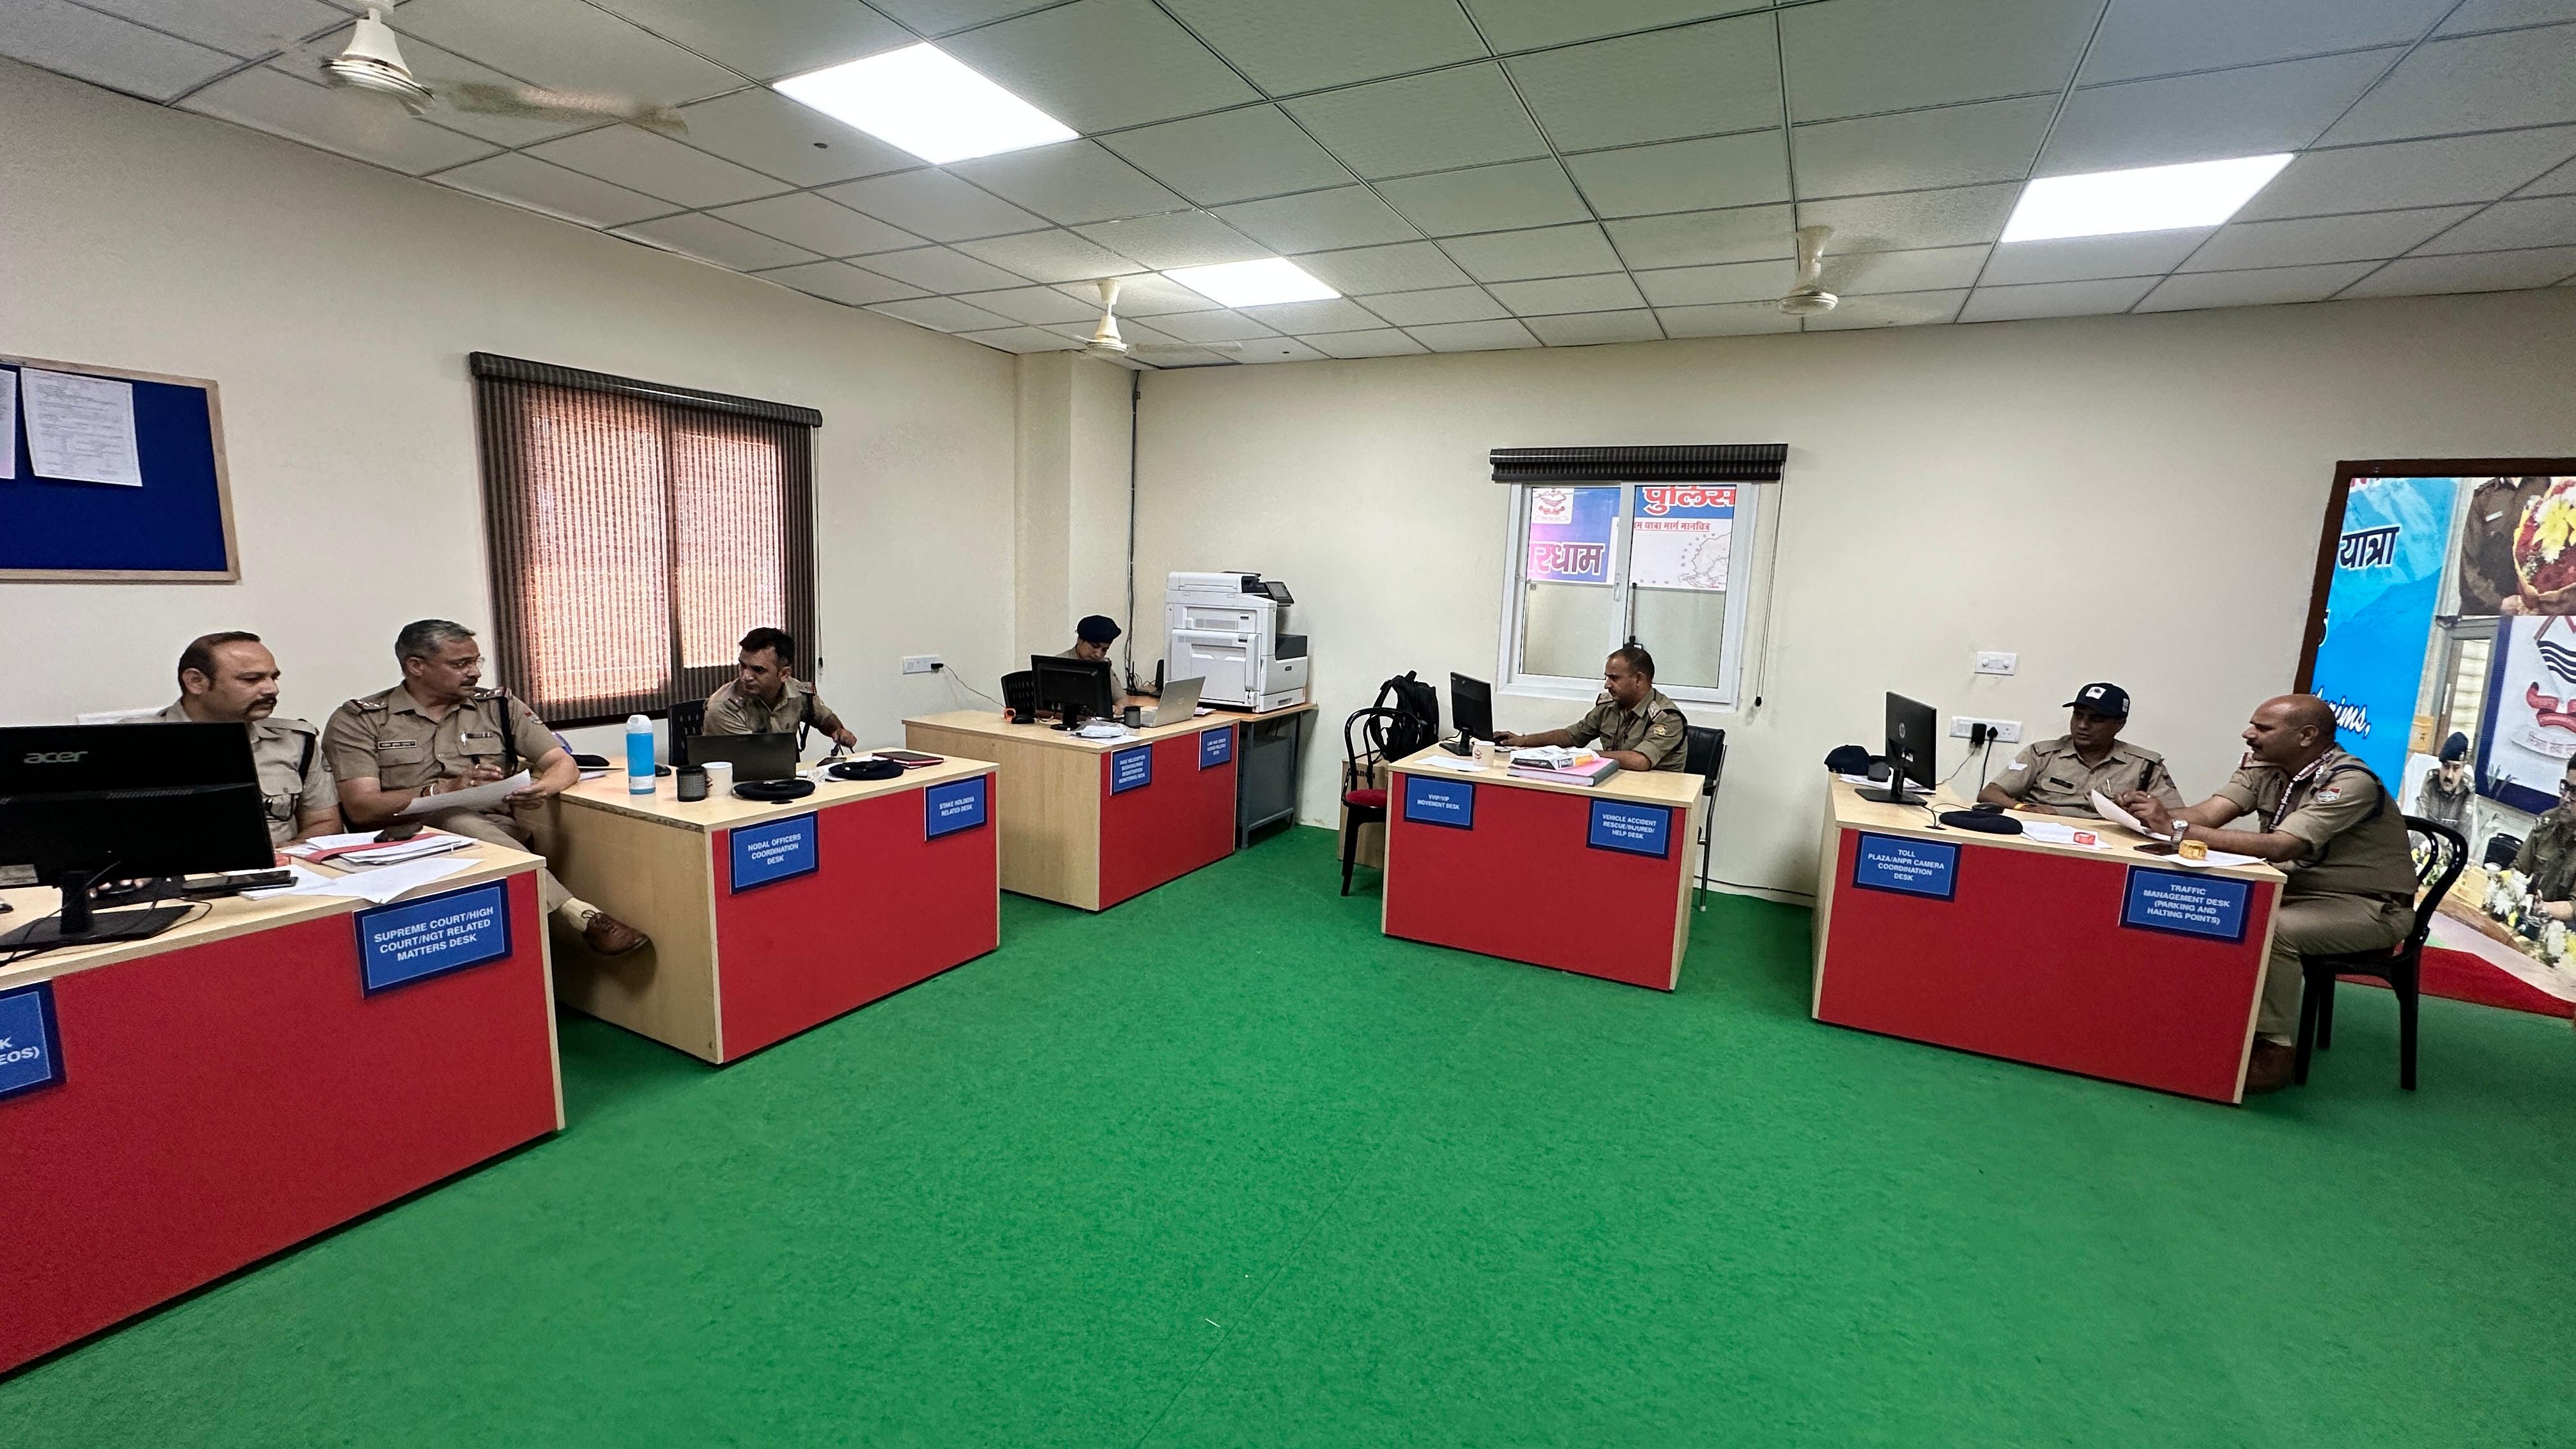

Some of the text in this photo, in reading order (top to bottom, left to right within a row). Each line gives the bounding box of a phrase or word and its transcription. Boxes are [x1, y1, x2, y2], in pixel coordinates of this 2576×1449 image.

[2340, 525, 2400, 569] यात्रा
[24, 751, 89, 764] acer
[939, 796, 974, 810] STAKE HOLDERS
[941, 804, 973, 816] RELATED DESK
[1417, 799, 1445, 808] MOVEMENT
[1602, 813, 1657, 827] VEHICLE ACCIDENT
[1628, 831, 1644, 839] DESK
[747, 833, 802, 852] NODAL OFFICERS
[751, 843, 799, 860] COORDINATION
[1897, 849, 1916, 857] TOLL
[767, 855, 785, 865] DESK
[1867, 853, 1945, 870] PLAZA/ANPR CAMERA
[1878, 862, 1933, 876] COORDINATION
[1894, 873, 1913, 882] DESK
[2170, 884, 2207, 895] TRAFFIC
[2143, 889, 2230, 907] MANAGEMENT DESK
[2154, 900, 2217, 914] (PARKING AND
[2147, 907, 2221, 925] HALTING POINTS)
[374, 907, 494, 943] SUPREME COURT/HIGH
[379, 919, 491, 954] COURT/NGT RELATED
[397, 933, 477, 961] MATTERS DESK
